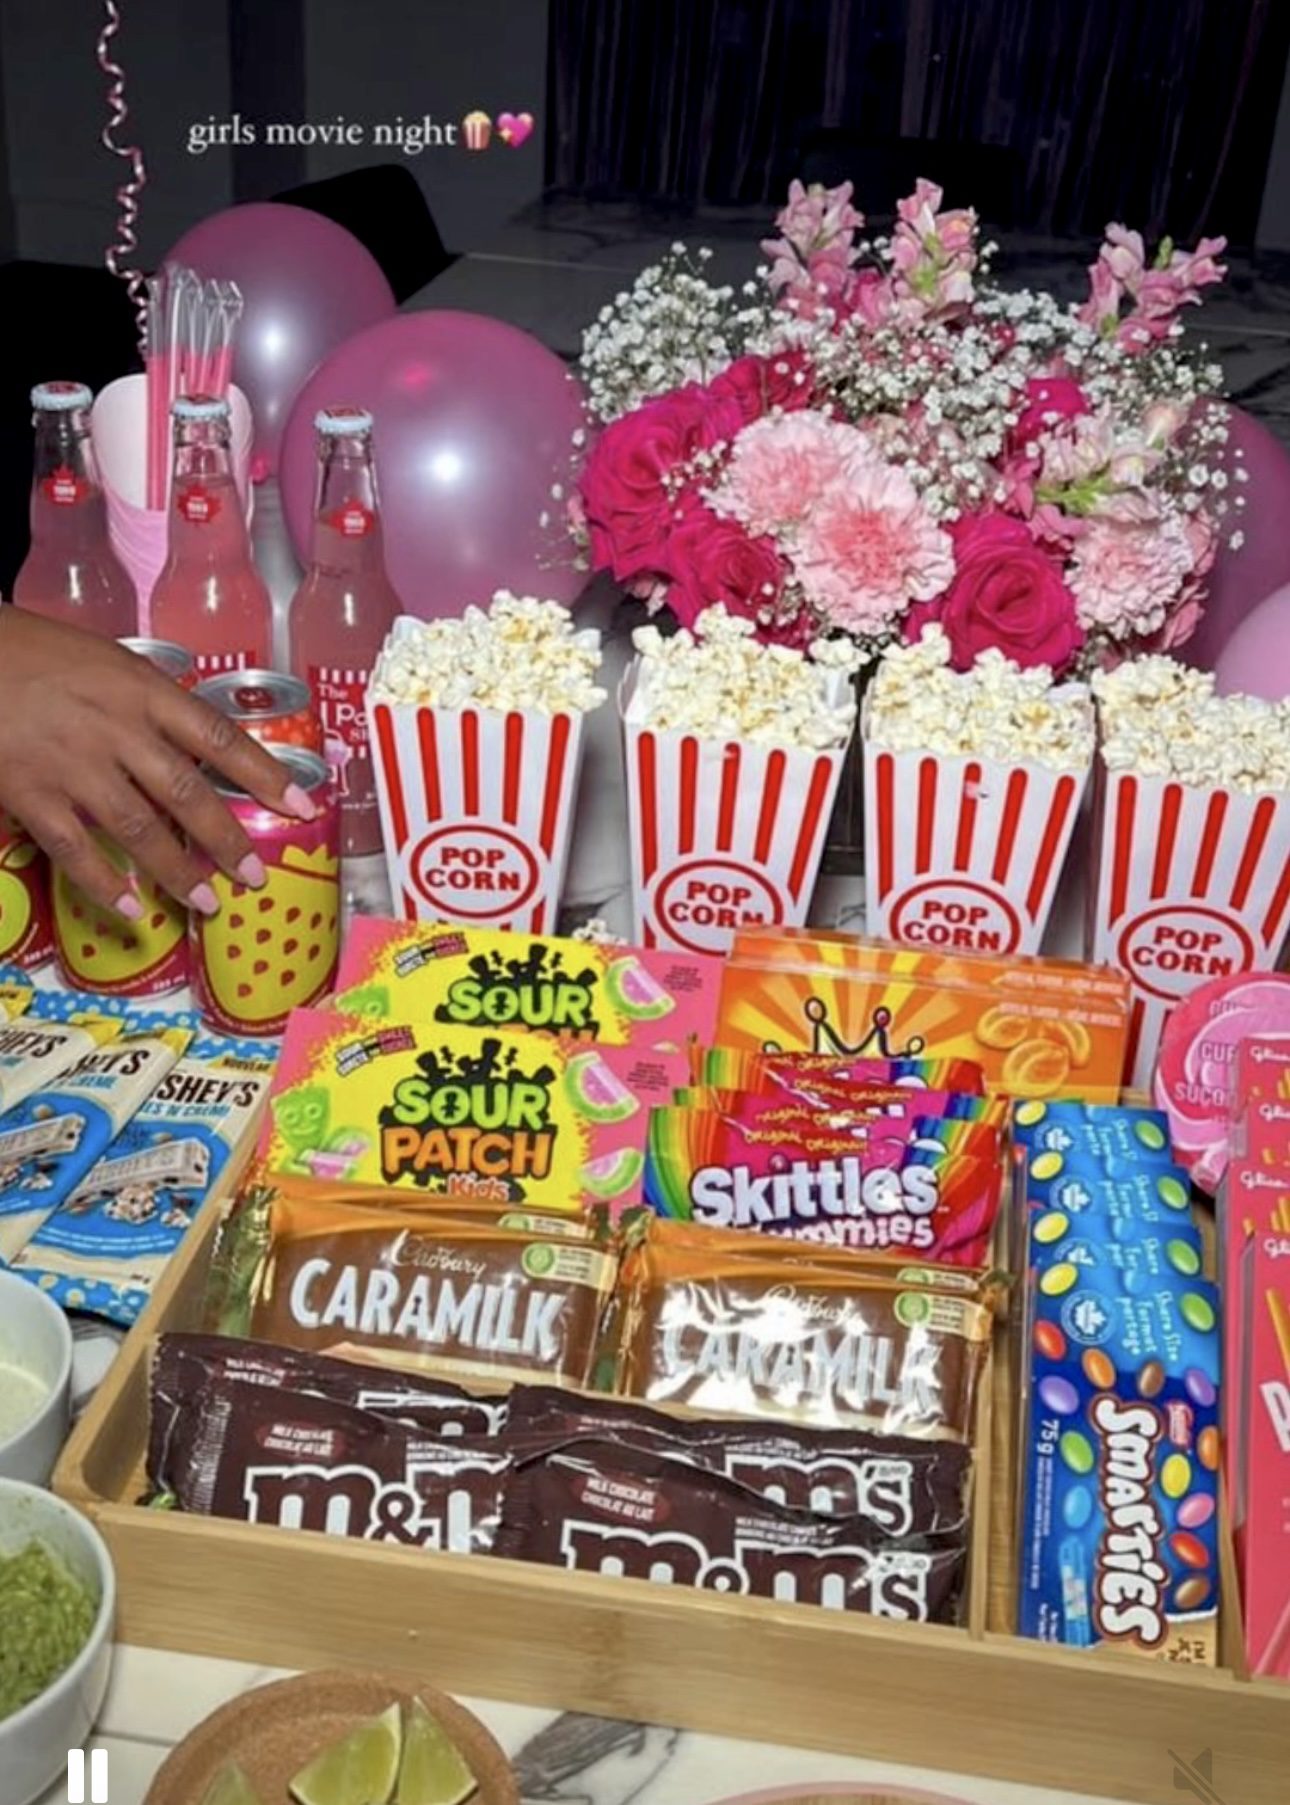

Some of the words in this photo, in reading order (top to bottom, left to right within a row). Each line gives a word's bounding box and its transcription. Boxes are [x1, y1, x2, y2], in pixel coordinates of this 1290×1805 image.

[335, 704, 369, 727] Po
[440, 846, 506, 869] POP
[425, 868, 520, 891] CORN
[686, 880, 753, 907] POP
[668, 902, 765, 928] CORN
[922, 901, 989, 926] POP
[903, 921, 1001, 950] CORN
[1153, 925, 1223, 953] POP
[1132, 946, 1233, 977] CORN
[447, 980, 590, 1028] SOUR
[156, 1074, 260, 1108] SHEY'S
[393, 1077, 548, 1130] SOUR
[382, 1126, 553, 1177] PATCH
[449, 1172, 511, 1200] Kids
[691, 1157, 940, 1228] Skittles
[289, 1257, 566, 1362] CARAMILK
